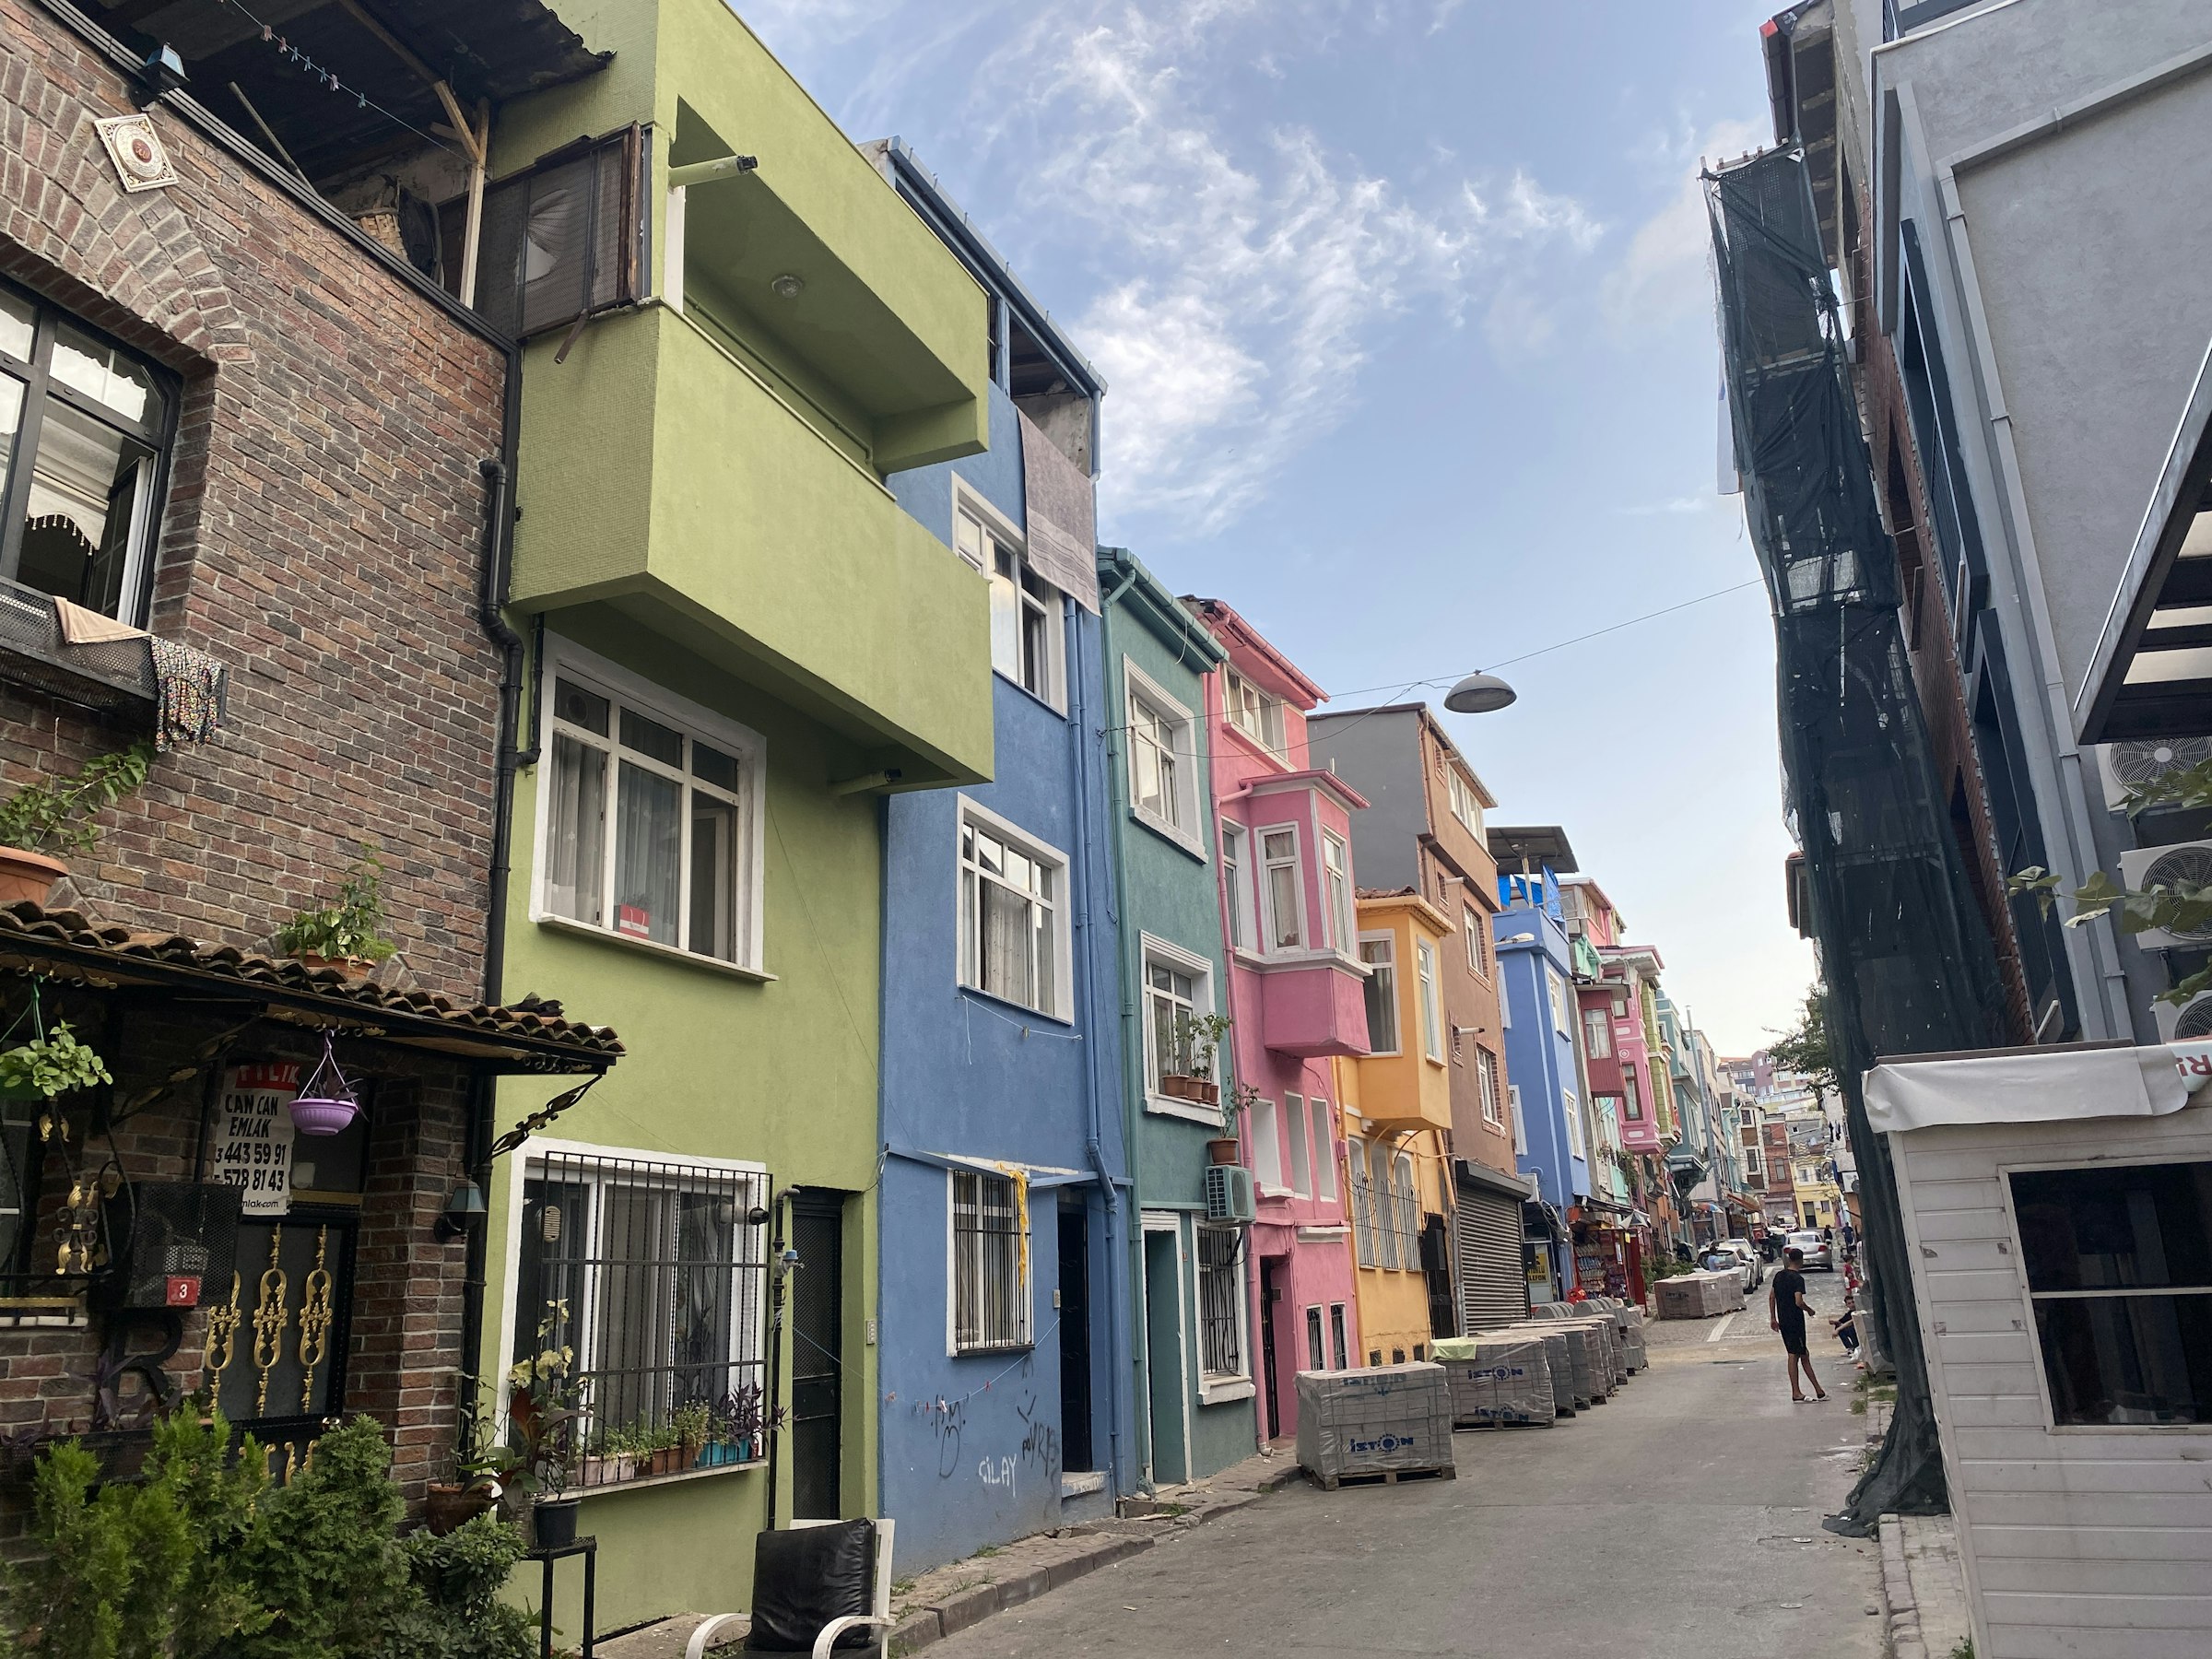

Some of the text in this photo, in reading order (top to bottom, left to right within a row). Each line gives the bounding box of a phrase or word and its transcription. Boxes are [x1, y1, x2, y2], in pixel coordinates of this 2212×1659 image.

[225, 1093, 279, 1116] CAN CAN
[229, 1117, 272, 1138] EMLAK
[254, 1143, 271, 1165] 59
[274, 1144, 287, 1165] 91
[253, 1169, 267, 1191] 81
[268, 1170, 285, 1192] 43
[179, 1283, 188, 1299] 3
